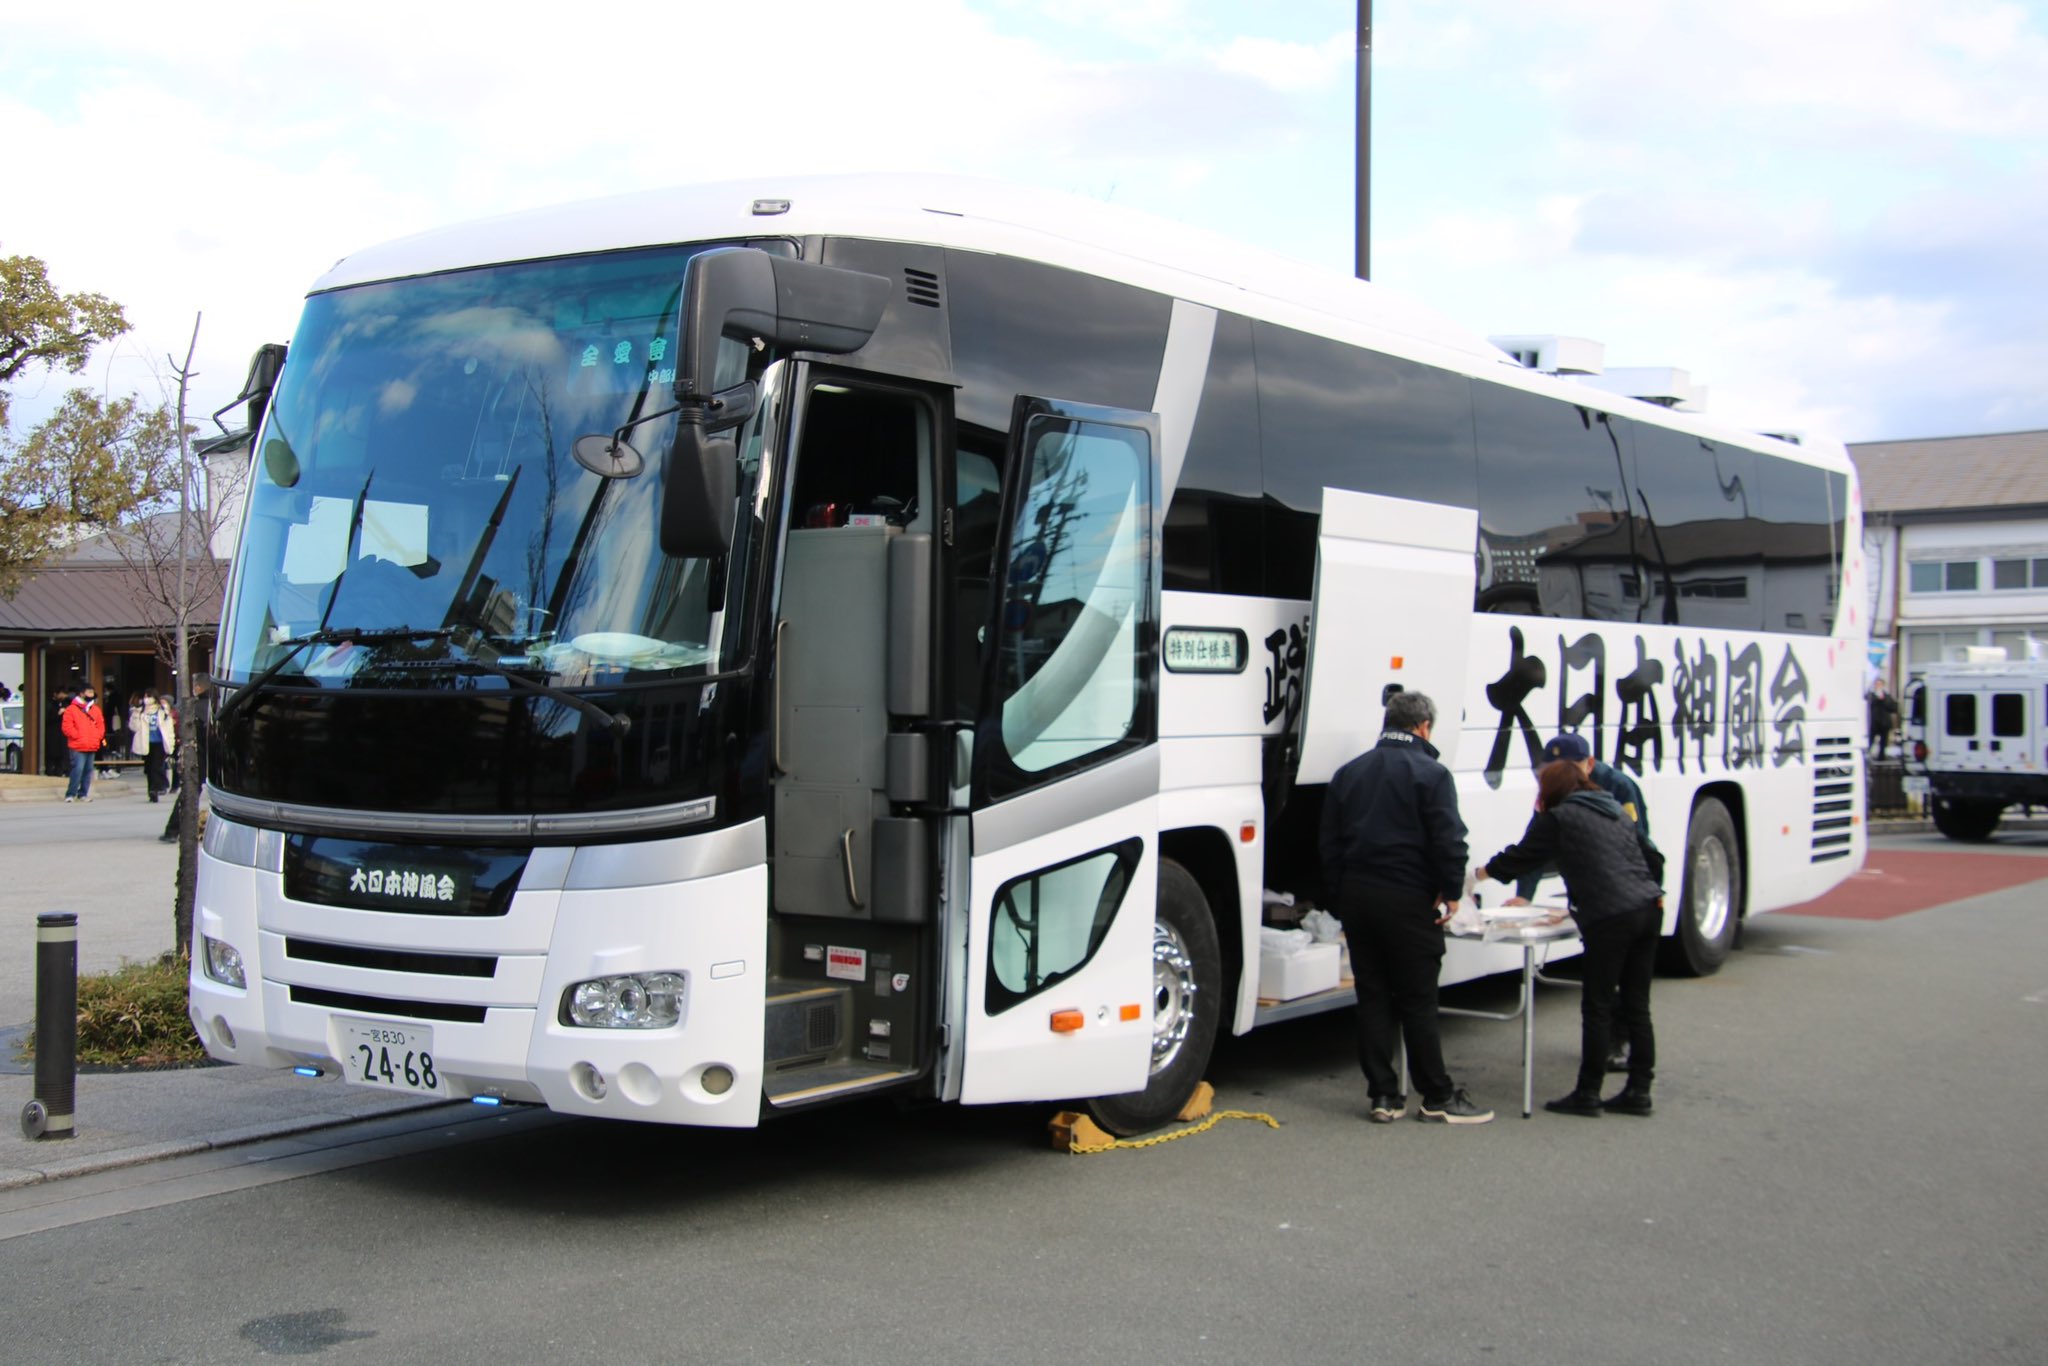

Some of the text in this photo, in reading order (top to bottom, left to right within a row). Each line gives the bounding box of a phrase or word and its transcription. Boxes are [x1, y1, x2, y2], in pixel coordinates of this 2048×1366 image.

[1169, 639, 1232, 661] 特別仕様車
[1484, 625, 1809, 791] 大日本神風会
[350, 867, 455, 901] 大日本神風会
[358, 1044, 438, 1089] 24-68
